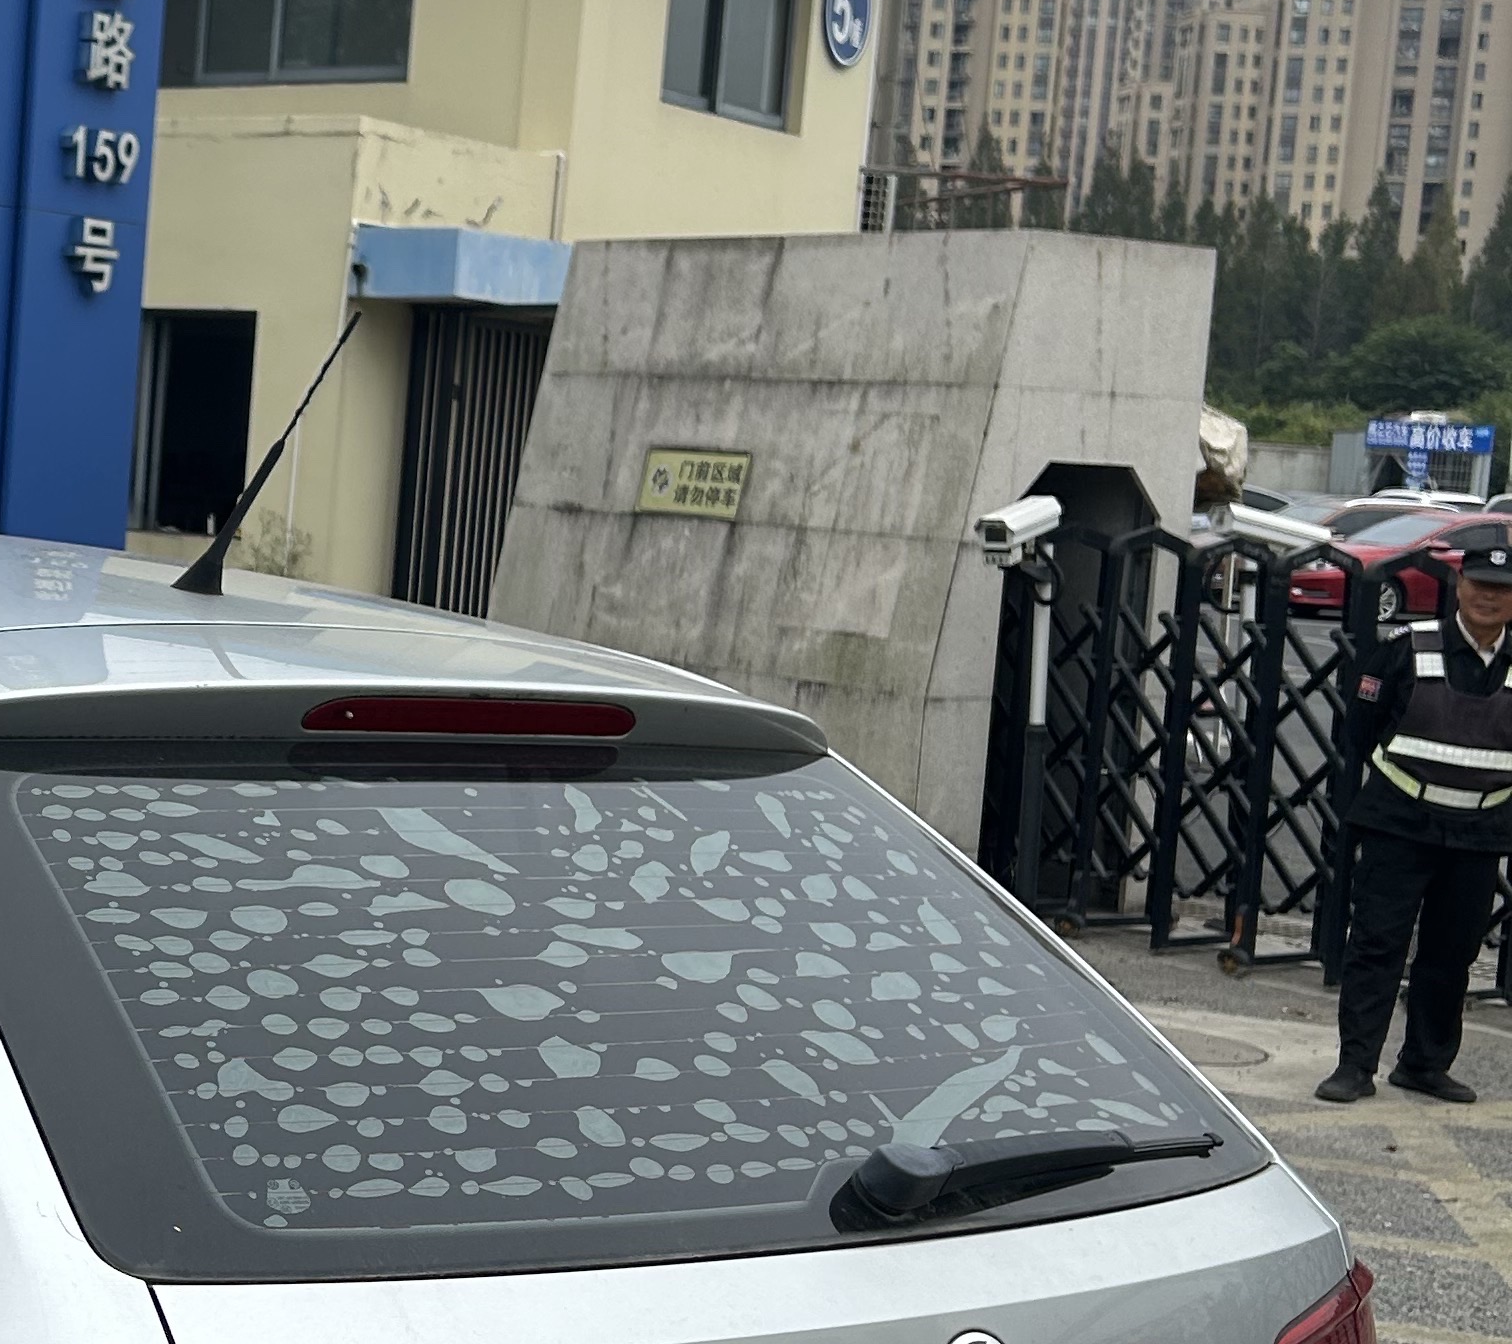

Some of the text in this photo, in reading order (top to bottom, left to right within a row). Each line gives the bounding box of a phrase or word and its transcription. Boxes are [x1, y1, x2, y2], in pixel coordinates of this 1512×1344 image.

[678, 460, 743, 484] 门前区域
[673, 484, 736, 509] 请勿停车
